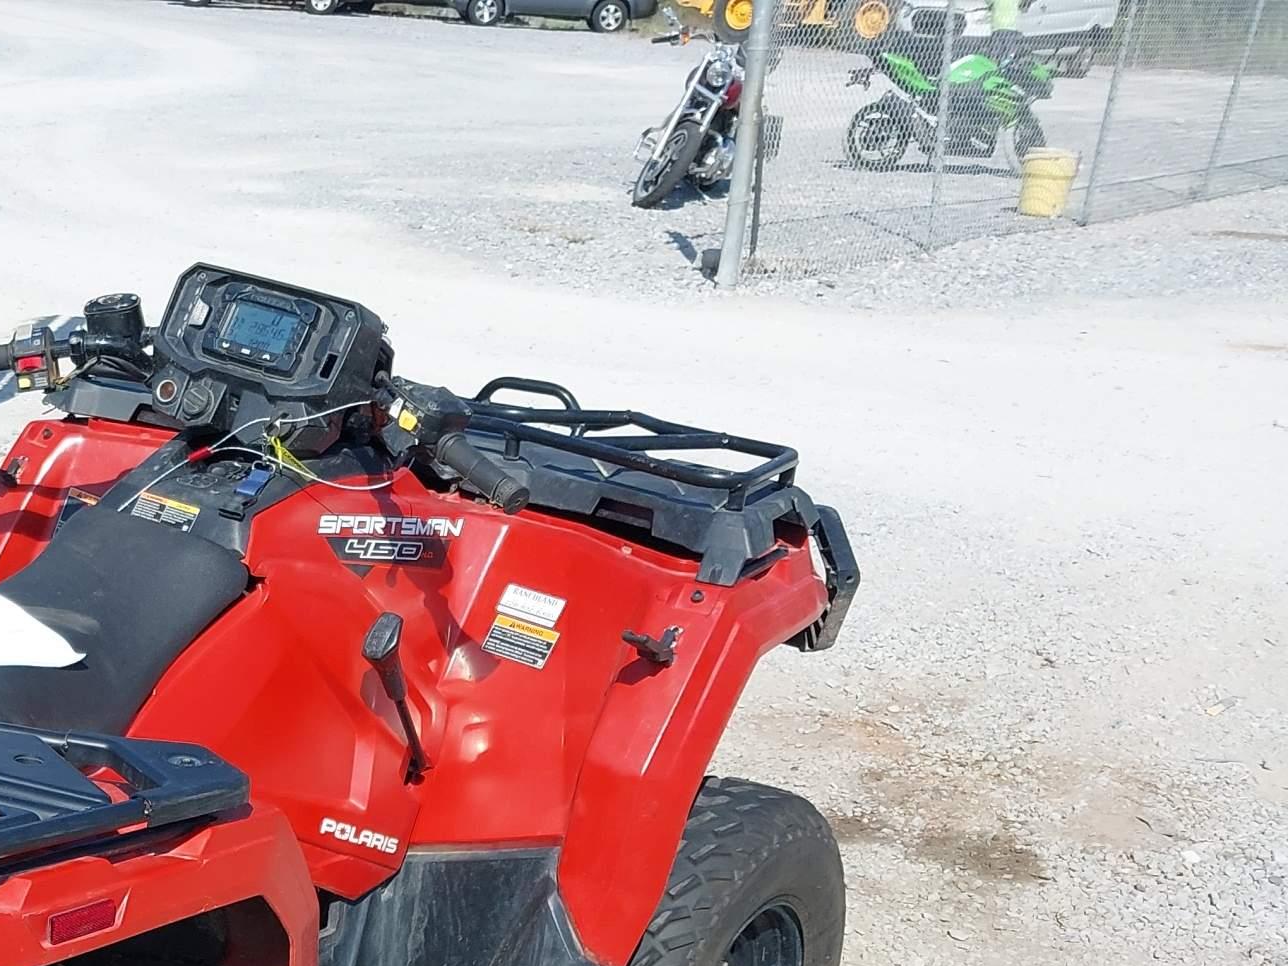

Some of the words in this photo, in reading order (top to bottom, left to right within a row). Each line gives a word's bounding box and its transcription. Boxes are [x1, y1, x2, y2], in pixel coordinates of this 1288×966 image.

[317, 515, 465, 537] SPORTSMAN
[345, 538, 424, 561] 450
[513, 587, 558, 607] RANCHLAND
[515, 624, 544, 636] WARNING
[319, 817, 399, 854] POLARIS
